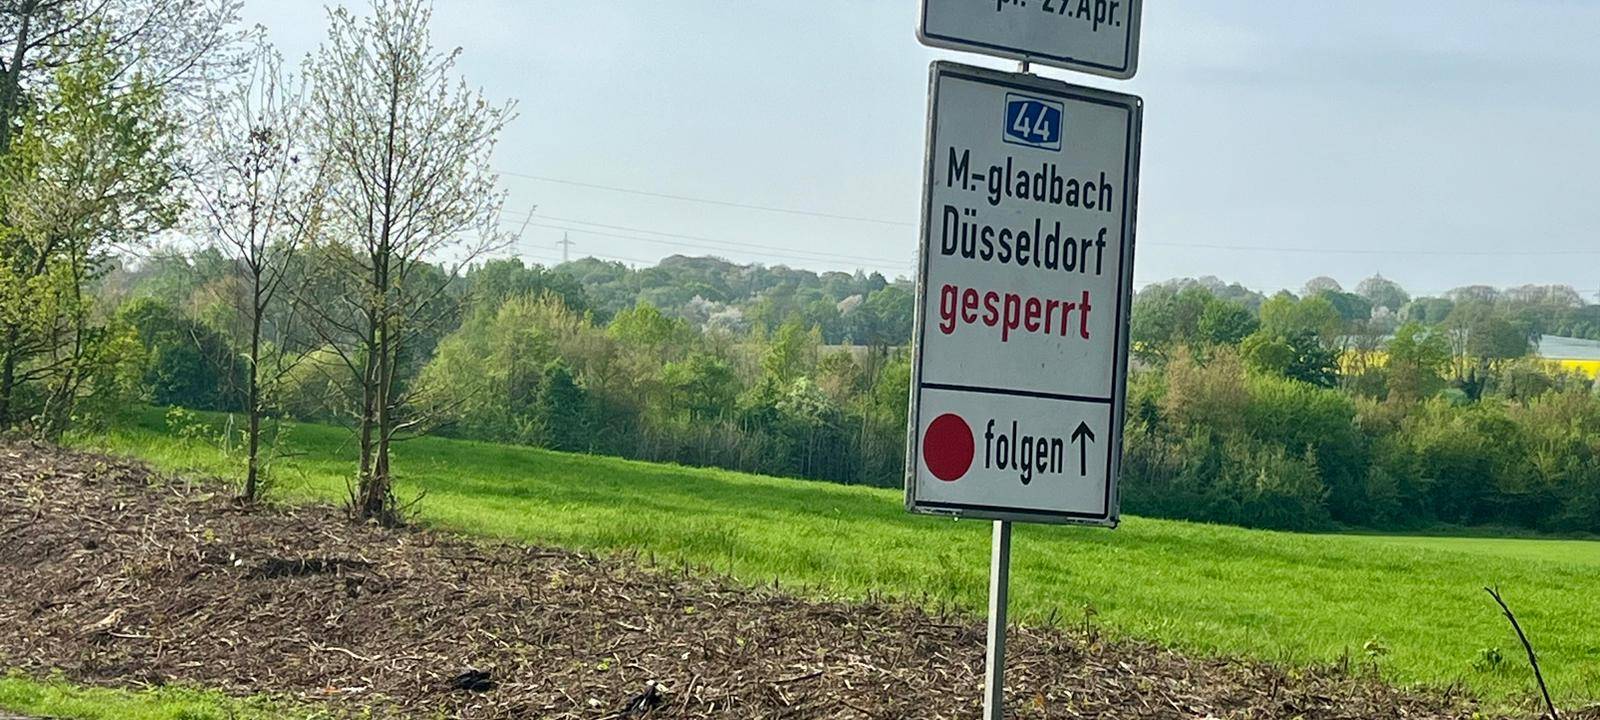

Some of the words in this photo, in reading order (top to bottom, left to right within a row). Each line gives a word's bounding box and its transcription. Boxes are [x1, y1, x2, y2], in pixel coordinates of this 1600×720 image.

[1013, 102, 1050, 141] 44
[947, 146, 1113, 213] M.-gladbach
[941, 205, 1107, 275] Düsseldorf
[939, 284, 1092, 342] gesperrt
[985, 419, 1064, 485] folgen
